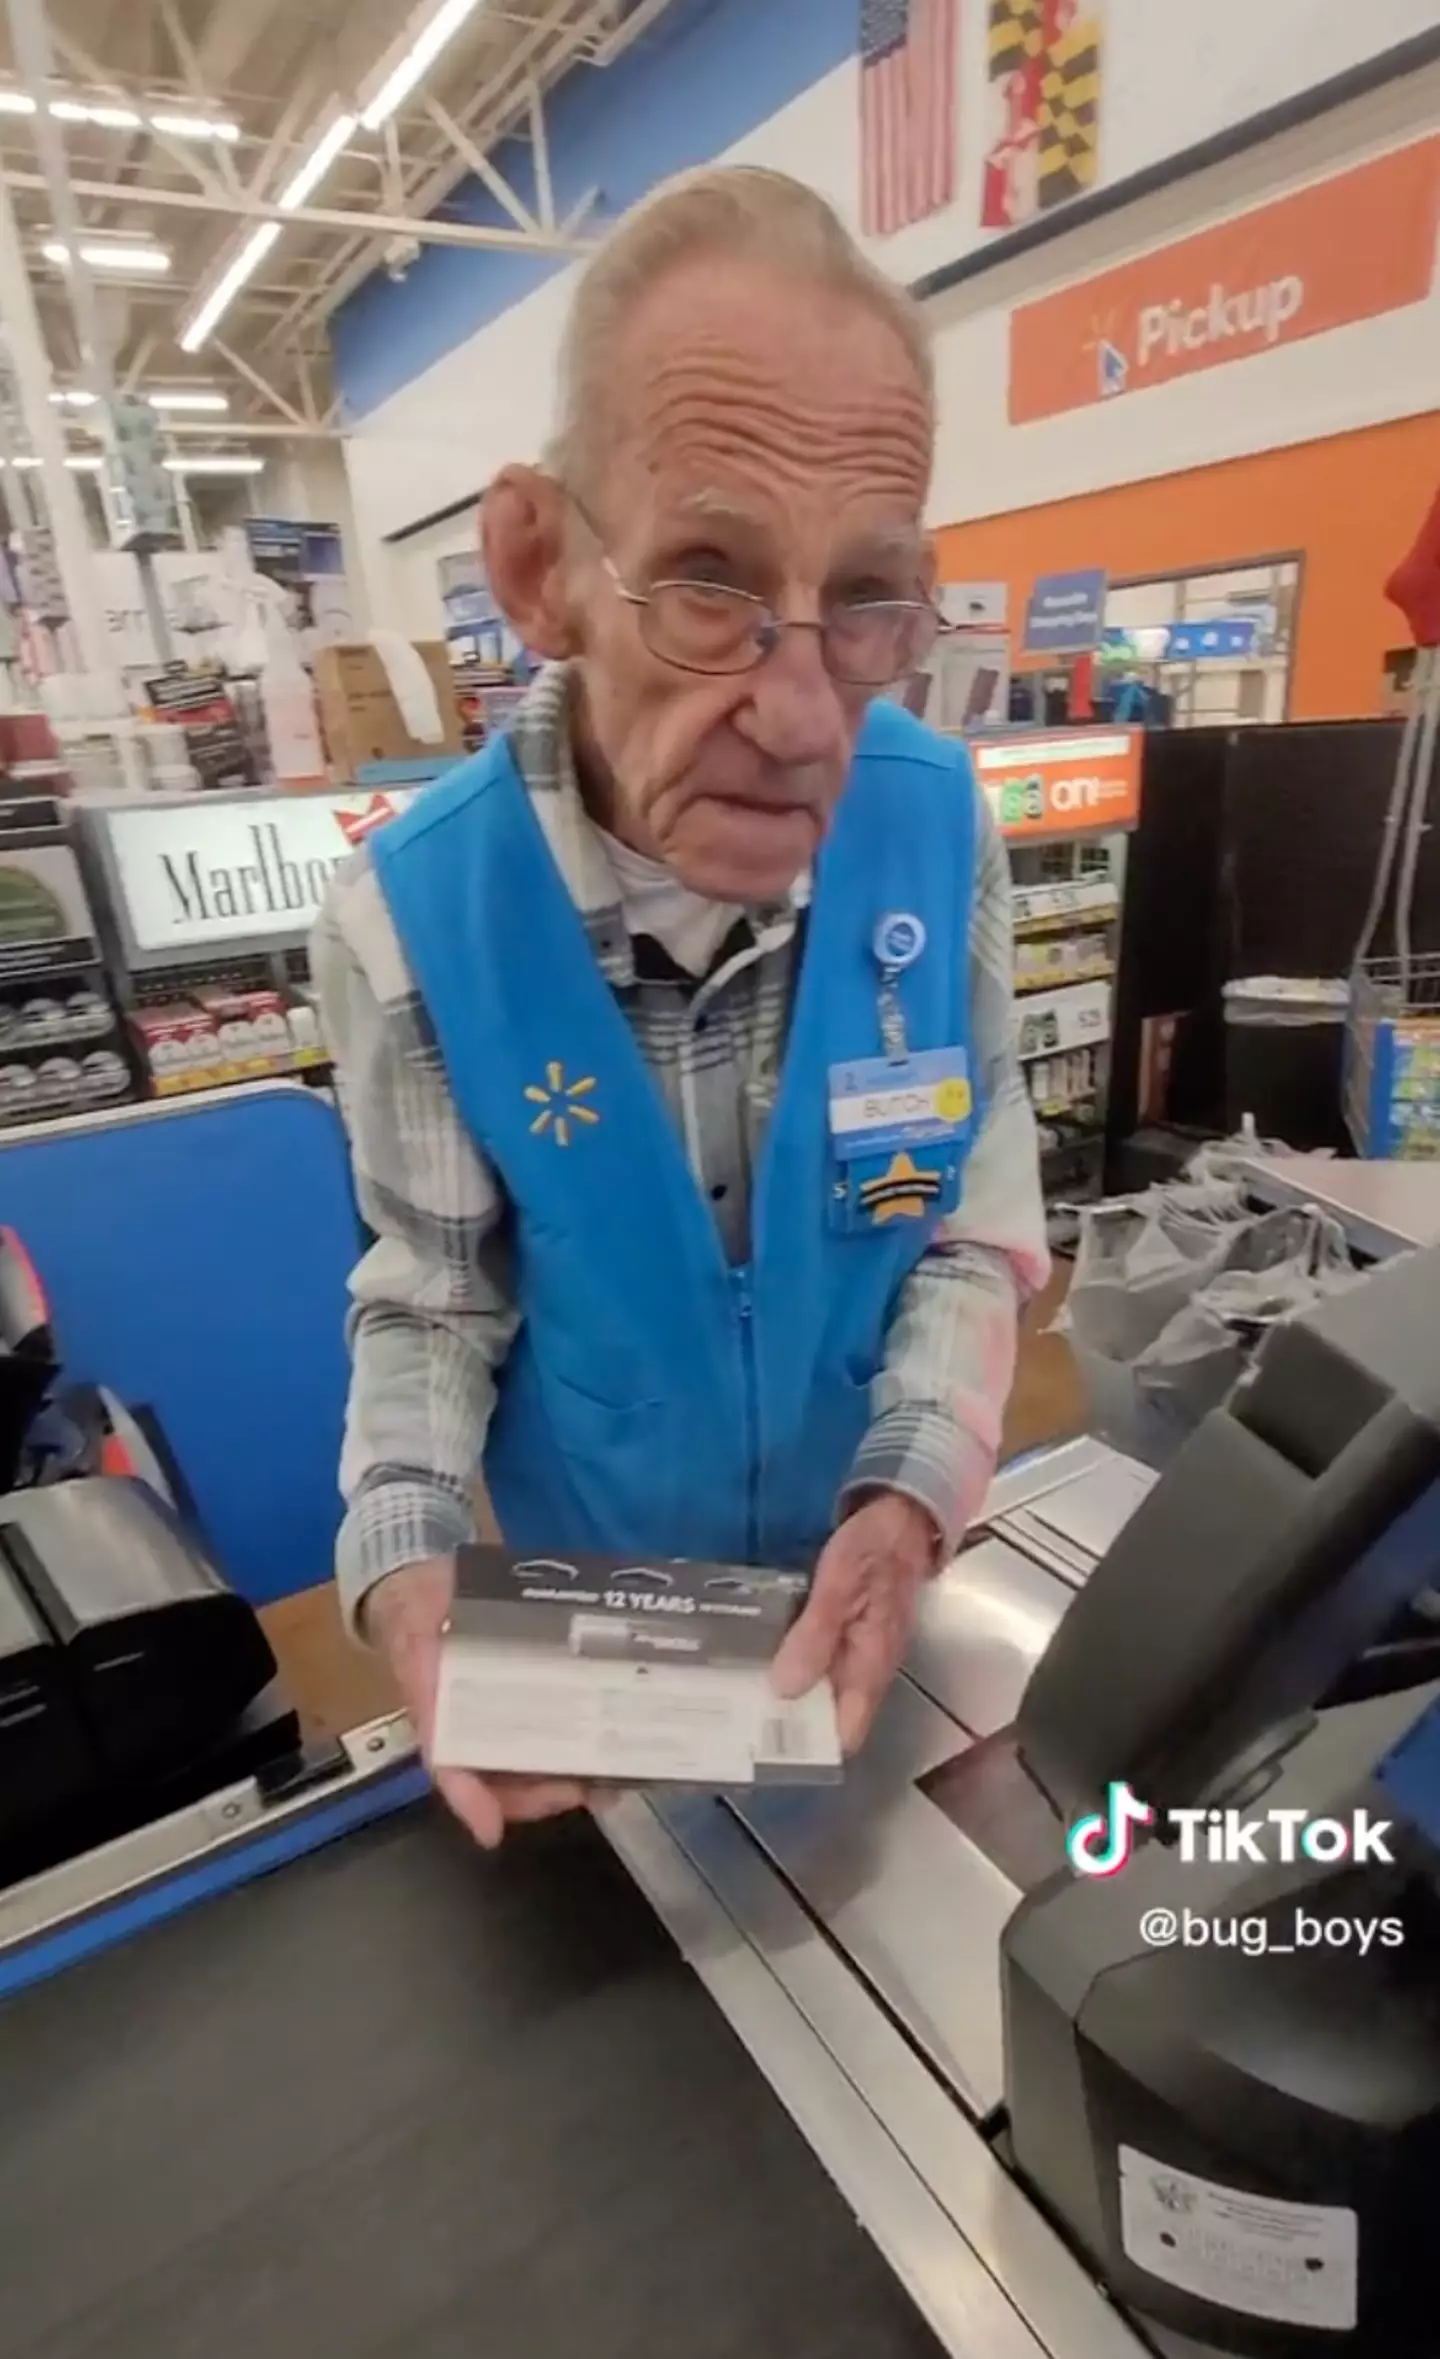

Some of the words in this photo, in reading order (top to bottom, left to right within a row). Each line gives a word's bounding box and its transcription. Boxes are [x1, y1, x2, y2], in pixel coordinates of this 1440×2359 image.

[1138, 275, 1304, 367] Pickup
[158, 822, 347, 925] Marlbo
[604, 1590, 626, 1609] 12
[629, 1592, 695, 1614] YEARS
